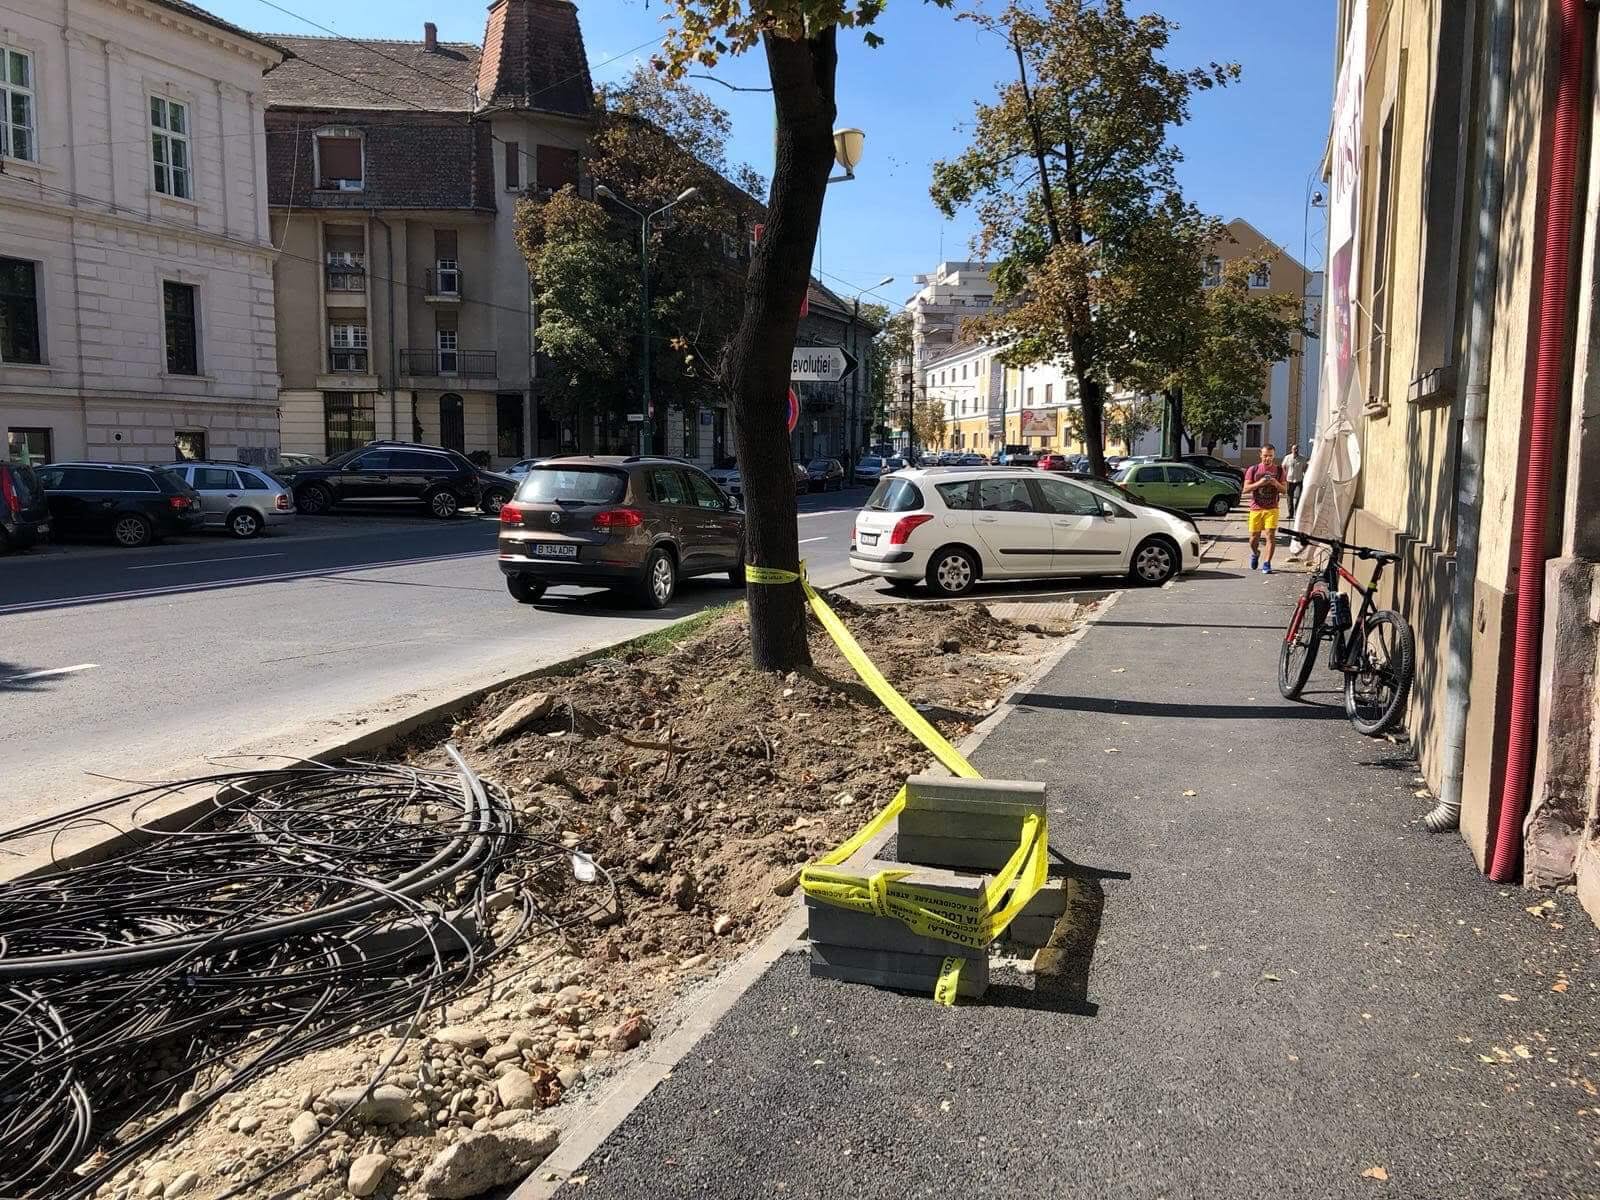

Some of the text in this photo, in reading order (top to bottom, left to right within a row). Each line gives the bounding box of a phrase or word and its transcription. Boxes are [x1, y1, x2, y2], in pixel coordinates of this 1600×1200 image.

[538, 545, 575, 555] B 134 ADR
[913, 895, 968, 911] ACCIDENTARE
